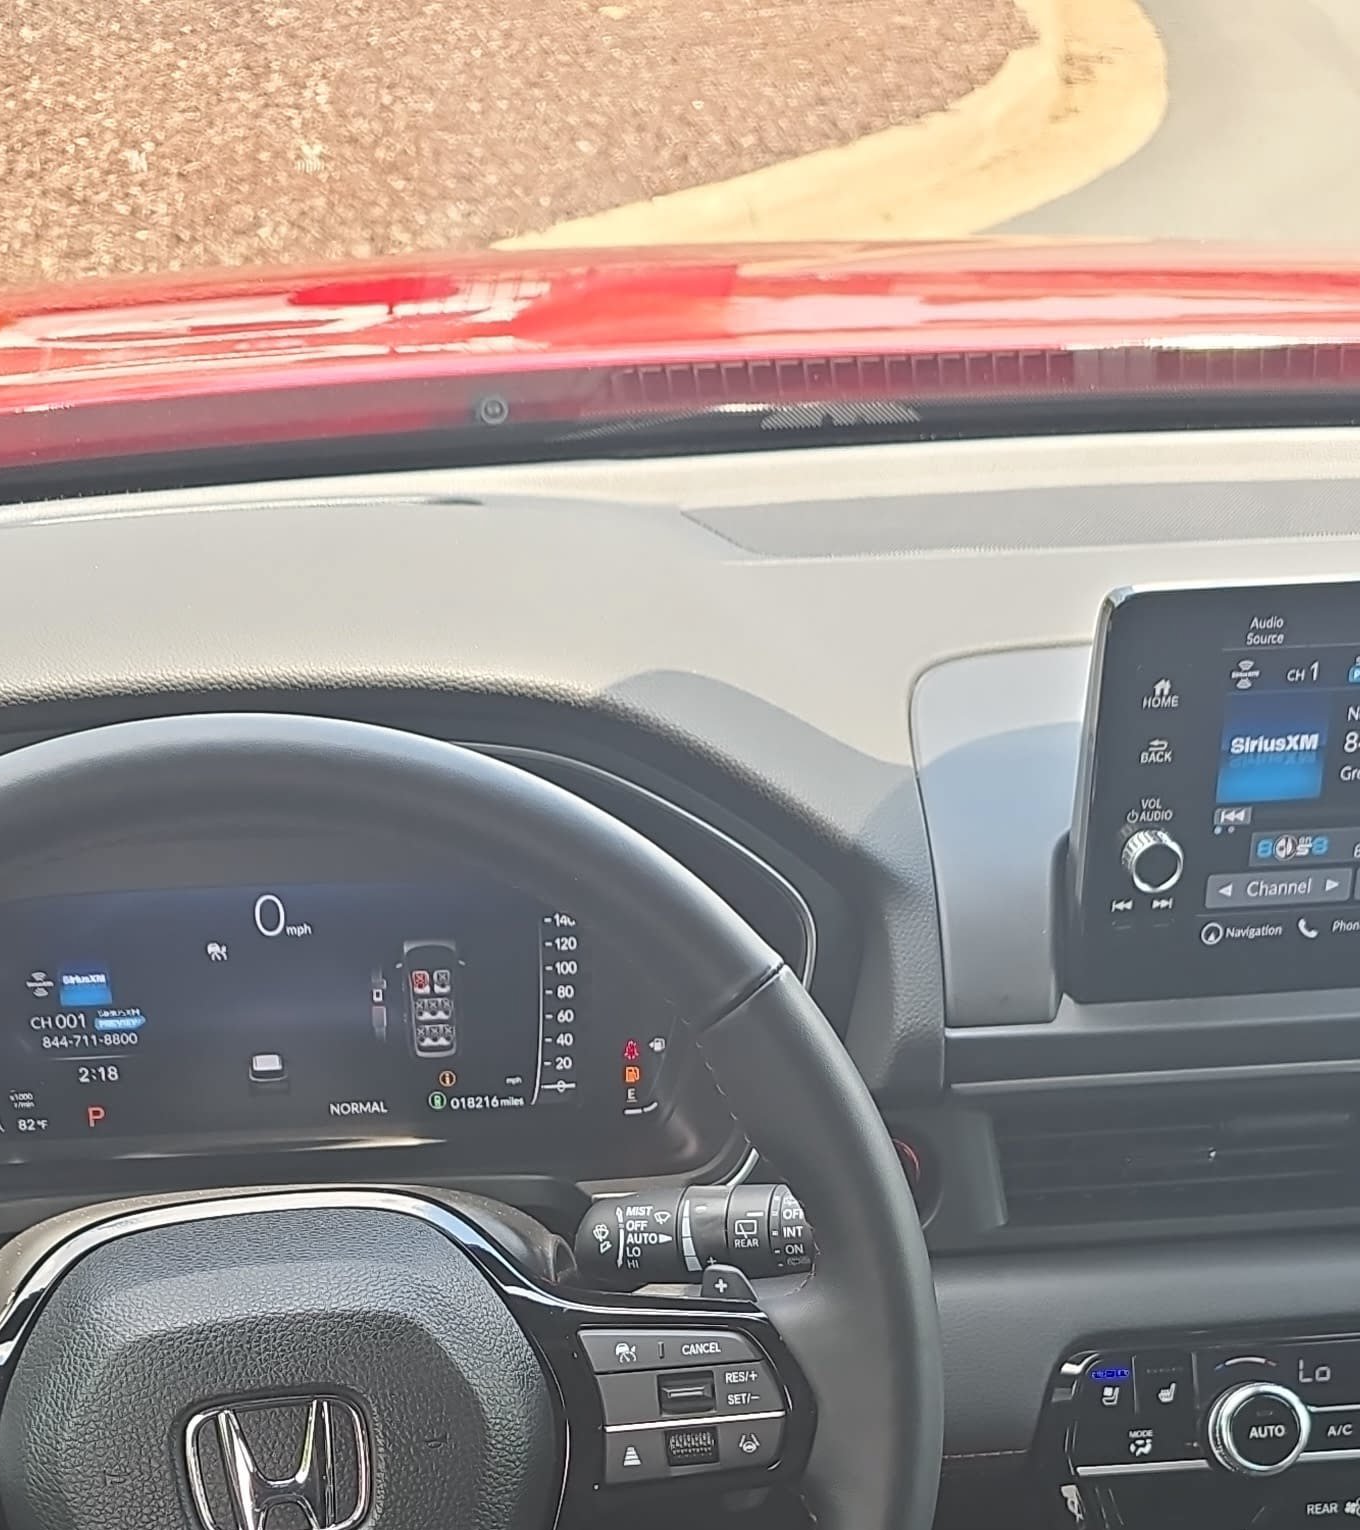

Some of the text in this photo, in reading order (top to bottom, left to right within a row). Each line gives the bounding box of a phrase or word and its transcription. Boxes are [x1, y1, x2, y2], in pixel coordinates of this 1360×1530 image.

[1250, 615, 1284, 630] Audio
[1246, 631, 1285, 646] Source
[1287, 661, 1320, 682] CH 1
[1142, 696, 1179, 709] HOME
[1230, 733, 1319, 755] SiriusXM
[1140, 750, 1172, 764] BACK
[1141, 799, 1162, 810] VOL
[1140, 810, 1173, 822] AUDIO
[1246, 879, 1313, 898] Channel
[254, 893, 286, 936] 0
[285, 923, 313, 937] mph
[1225, 923, 1283, 943] Navigation
[554, 936, 578, 951] 120
[554, 961, 578, 976] 100
[557, 985, 575, 999] 80
[30, 1012, 87, 1030] CH 001
[557, 1009, 575, 1024] 60
[42, 1032, 138, 1049] 844-711-8800
[556, 1033, 574, 1047] 40
[555, 1056, 573, 1070] 20
[78, 1066, 119, 1083] 2:18
[627, 1089, 636, 1101] E
[329, 1101, 388, 1116] NORMAL
[450, 1095, 525, 1110] 018216 miles
[87, 1106, 105, 1128] P
[626, 1205, 653, 1217] MIST
[626, 1220, 648, 1232] OFF
[782, 1225, 804, 1238] INT
[626, 1232, 658, 1245] AUTO
[734, 1238, 759, 1249] REAR
[626, 1247, 641, 1258] LO
[785, 1243, 804, 1255] ON
[627, 1259, 639, 1269] HI
[682, 1342, 721, 1356] CANCEL
[725, 1370, 758, 1384] RES/+
[1297, 1359, 1331, 1384] Lo
[1129, 1430, 1153, 1438] MODE
[1249, 1424, 1286, 1440] AUTO
[1327, 1424, 1353, 1437] A/C
[1307, 1503, 1338, 1516] REAR
